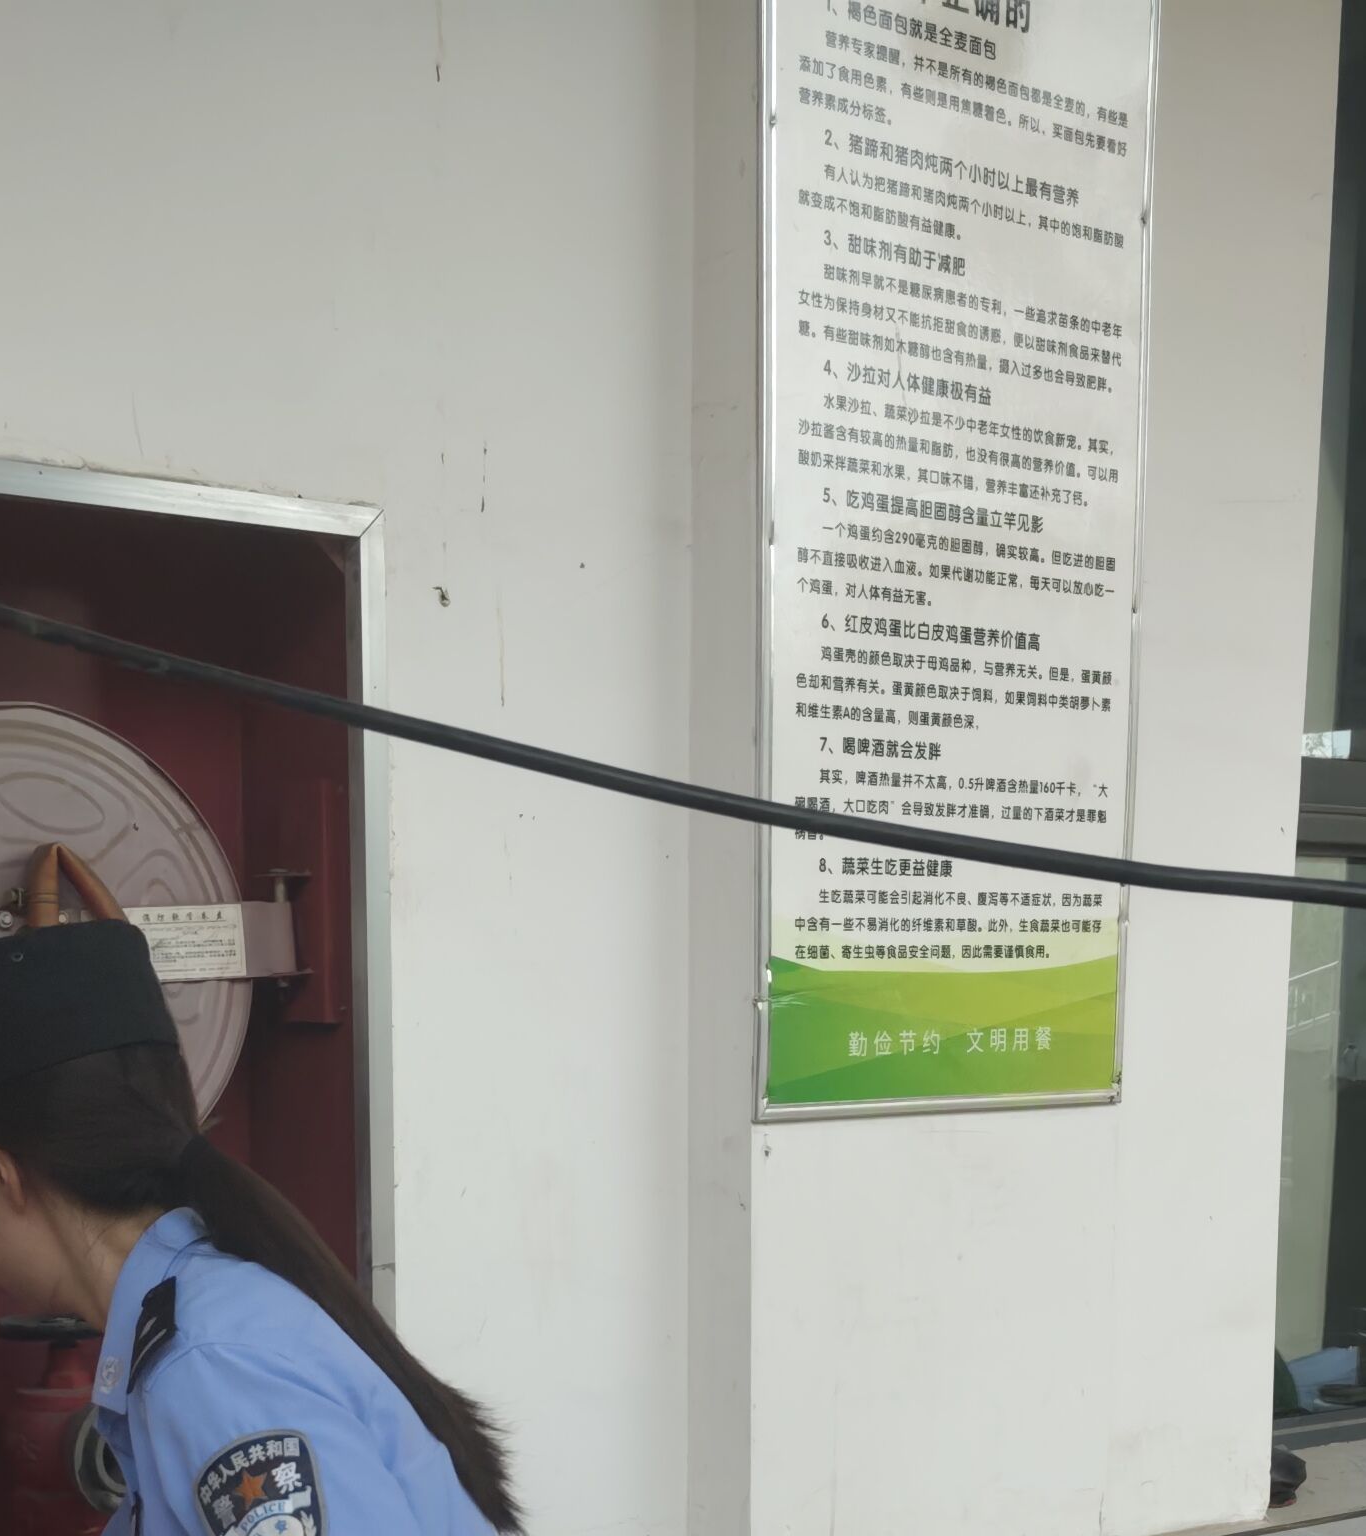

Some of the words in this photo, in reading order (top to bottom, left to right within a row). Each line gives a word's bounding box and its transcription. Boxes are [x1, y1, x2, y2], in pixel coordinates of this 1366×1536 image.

[824, 127, 1079, 208] 2、猪蹄和猪肉炖两个小时以上最有营养
[824, 227, 965, 277] 3、甜味剂有助于减肥
[824, 358, 991, 406] 4、沙拉对人体健康极有益
[823, 486, 1043, 534] 5、吃鸡蛋提高胆固醇含量立竿见影
[821, 611, 1040, 651] 6、红皮鸡蛋比白皮鸡蛋营养价值高
[819, 735, 941, 761] 7、喝啤酒就会发胖
[818, 857, 952, 877] 8、蔬菜生吃更益健康
[847, 1030, 941, 1057] 勤俭节约
[966, 1026, 1053, 1054] 文明用餐
[199, 1437, 300, 1504] 中华人民共和国
[241, 1500, 286, 1534] POLICE
